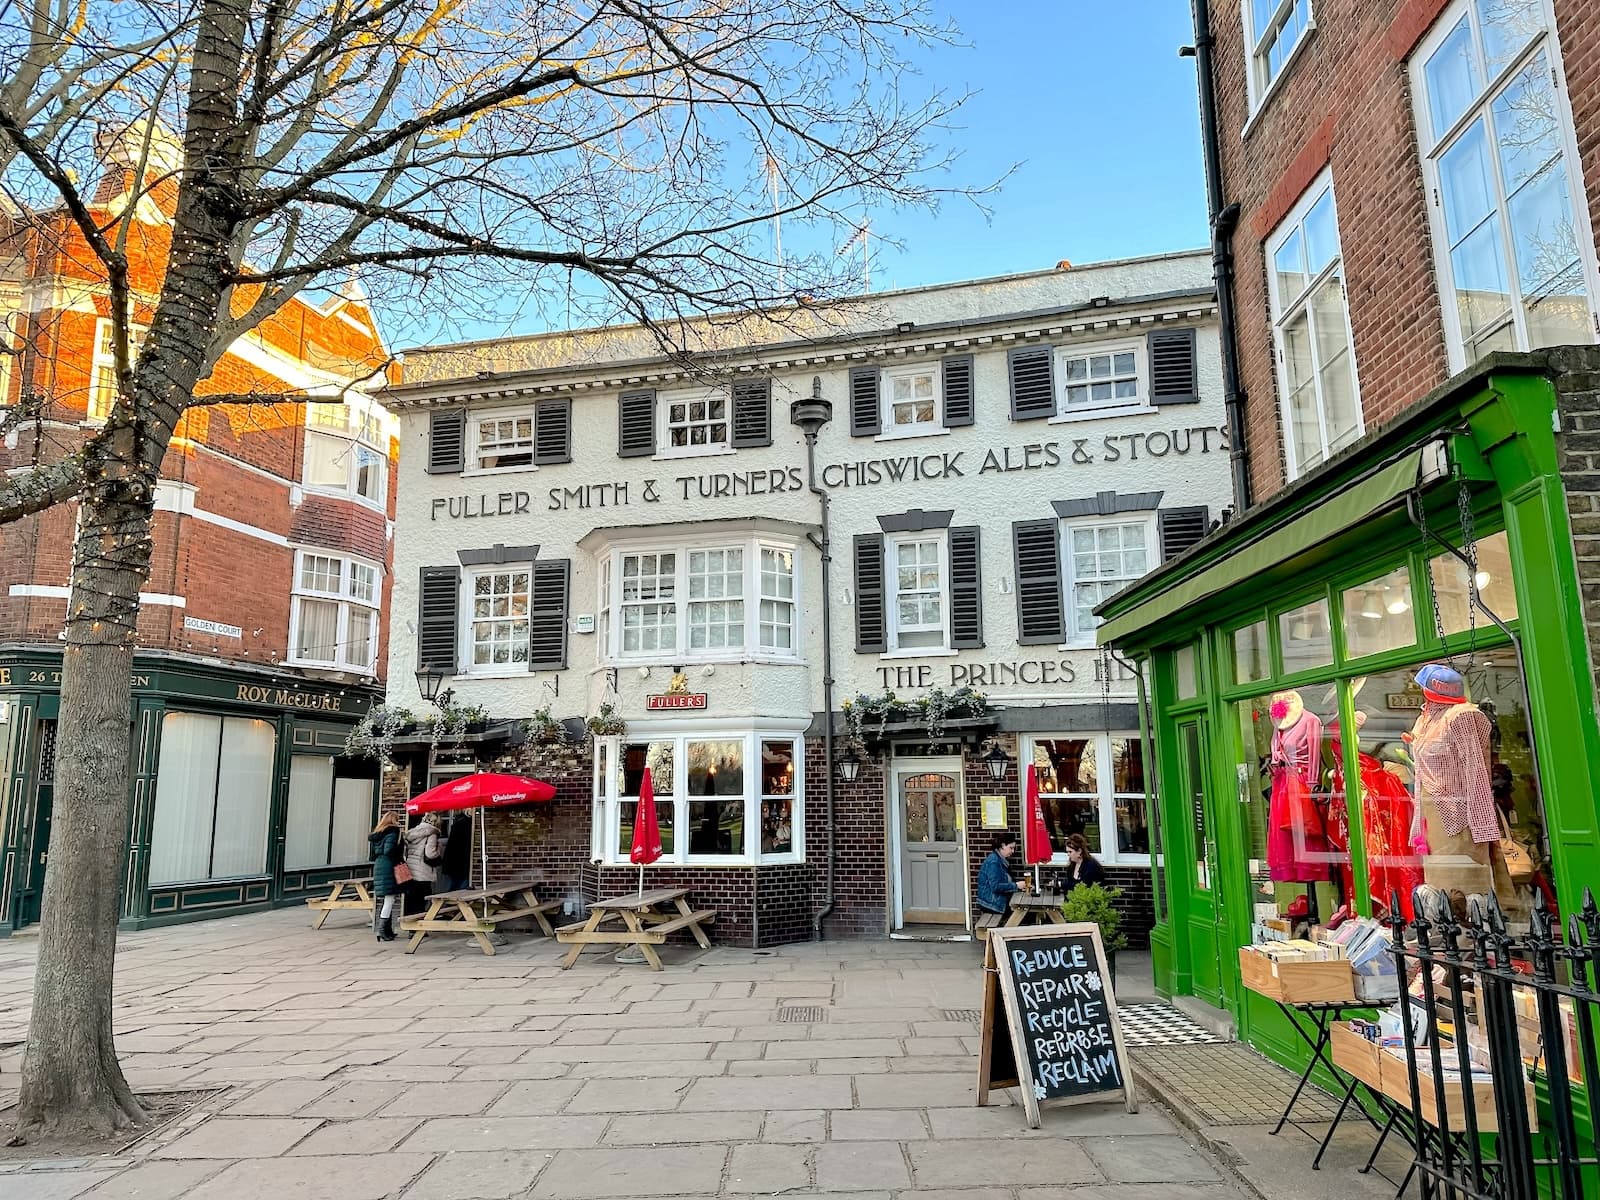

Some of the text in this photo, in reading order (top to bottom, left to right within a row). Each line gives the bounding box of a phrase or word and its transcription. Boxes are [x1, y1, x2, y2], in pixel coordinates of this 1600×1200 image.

[431, 491, 530, 520] FULLER
[549, 481, 629, 510] SMITH
[643, 479, 660, 502] &
[675, 465, 804, 500] TURNER'S
[822, 451, 965, 488] CHISWICK
[978, 442, 1060, 475] ALES
[1071, 438, 1094, 464] &
[185, 617, 240, 637] GOLDEN COURT
[29, 671, 46, 682] 26
[876, 664, 934, 688] THE
[950, 659, 1075, 687] PRINCES
[236, 684, 341, 712] ROY McCLURE
[650, 695, 702, 707] FULLER'S
[1019, 974, 1091, 1010] REPAIR
[1026, 998, 1102, 1033] RECYCLE
[1038, 1049, 1121, 1089] RECLAIM
